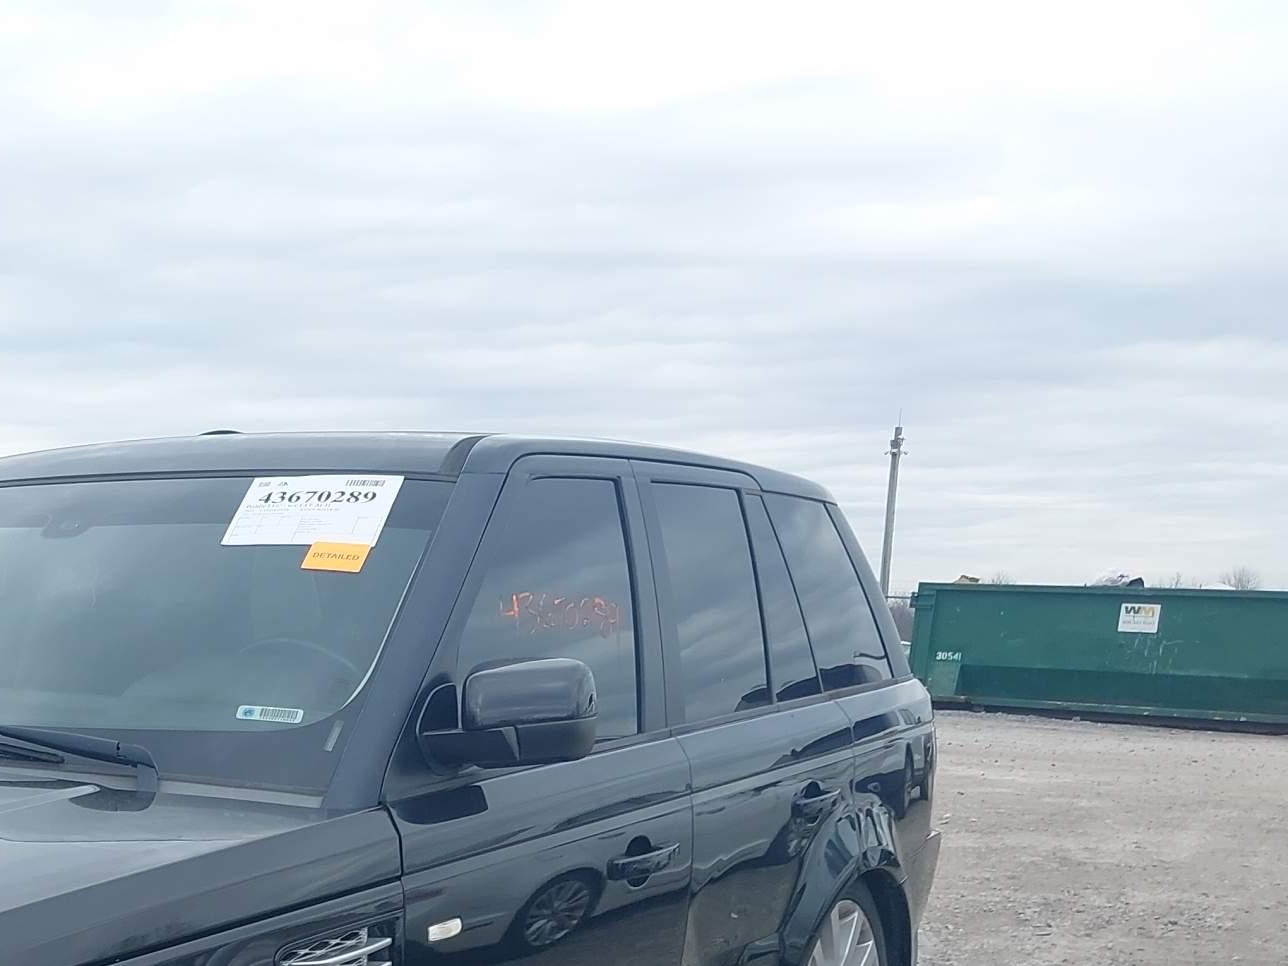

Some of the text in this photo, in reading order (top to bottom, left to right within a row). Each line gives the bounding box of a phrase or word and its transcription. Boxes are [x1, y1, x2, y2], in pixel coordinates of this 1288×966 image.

[258, 490, 377, 504] 43670289
[312, 551, 360, 561] DETAILED
[1123, 605, 1155, 618] WM
[935, 651, 962, 662] 30541
